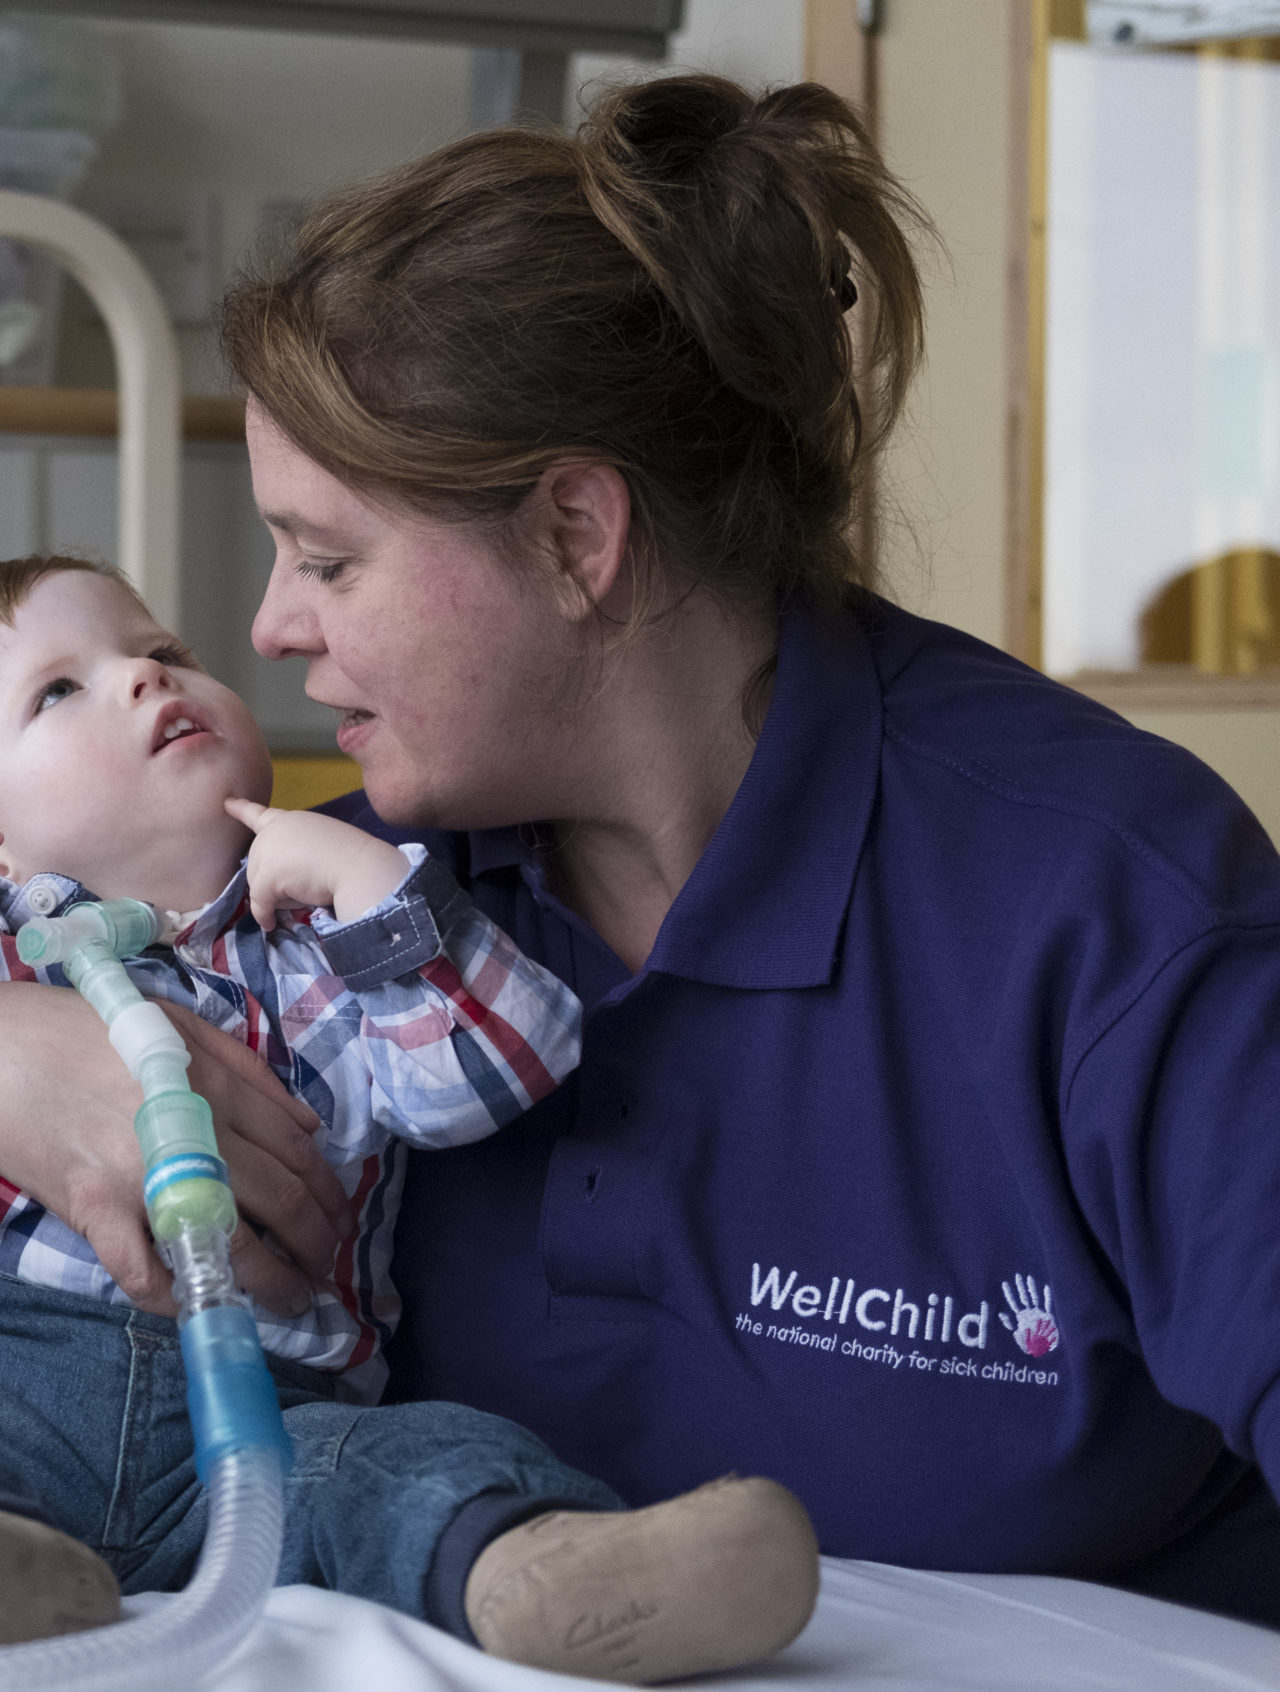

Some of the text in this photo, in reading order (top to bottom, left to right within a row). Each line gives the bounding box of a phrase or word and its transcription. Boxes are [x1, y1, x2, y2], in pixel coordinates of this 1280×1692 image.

[751, 1262, 989, 1349] WellChild
[735, 1312, 1058, 1386] the national charity for sick children
